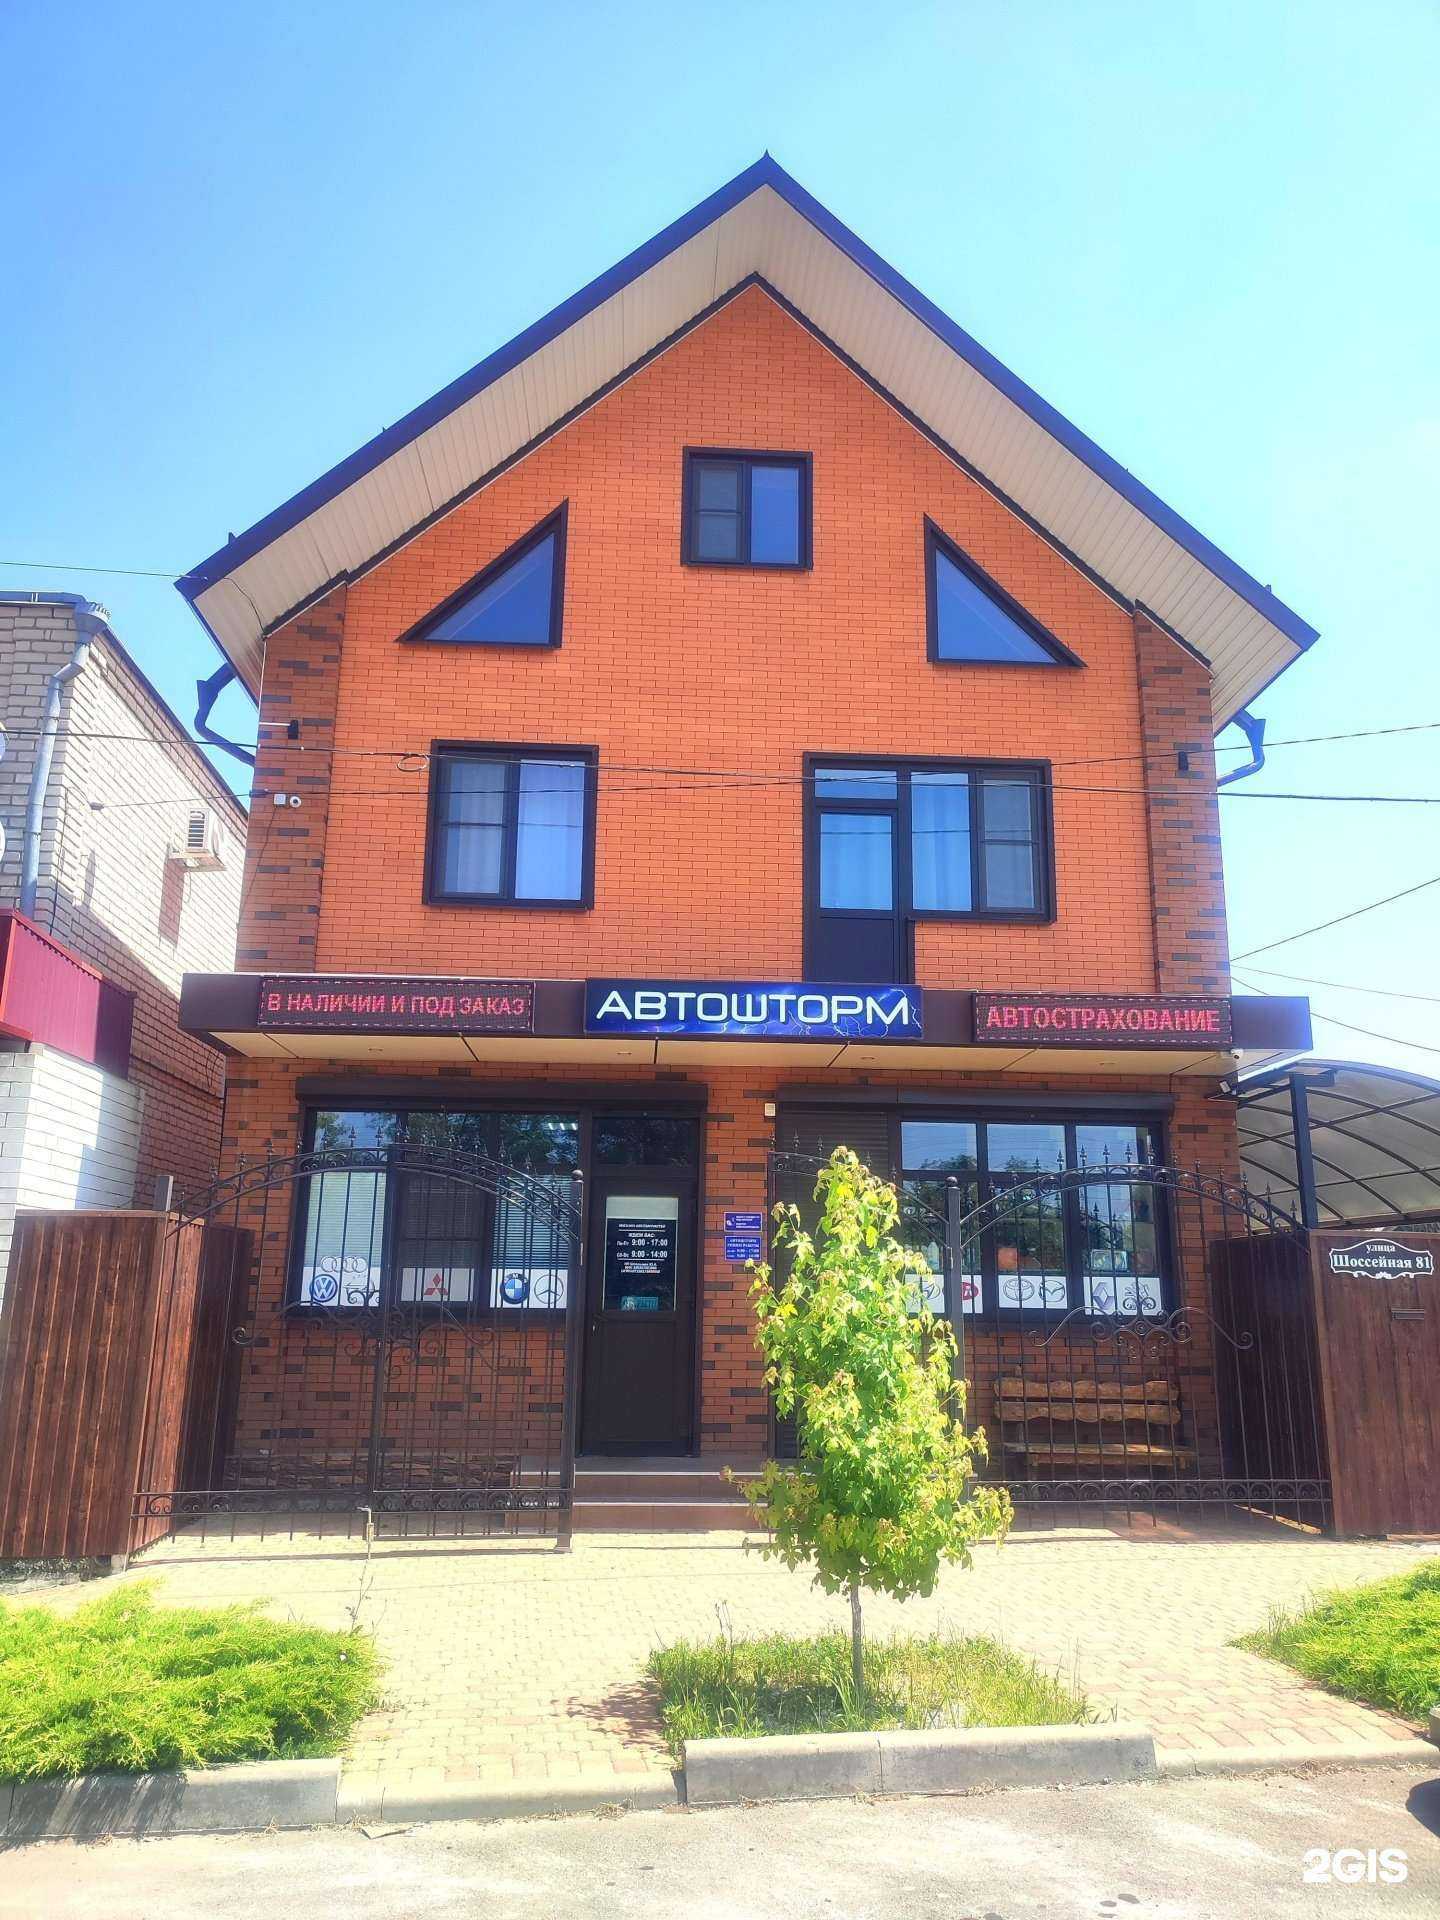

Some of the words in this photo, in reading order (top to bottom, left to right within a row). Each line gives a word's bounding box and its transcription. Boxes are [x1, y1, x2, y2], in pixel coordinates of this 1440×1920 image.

[267, 993, 281, 1011] В
[287, 993, 385, 1013] НАЛИЧИИ
[391, 995, 404, 1013] И
[411, 996, 454, 1018] ПОД
[459, 997, 524, 1015] ЗАКАЗ
[596, 990, 909, 1025] АВТОШТОРМ
[986, 1006, 1221, 1032] АВТОСТРАХОВАНИЕ
[631, 1238, 645, 1246] 9:00
[651, 1238, 668, 1247] 17:00
[1366, 1244, 1396, 1254] улица
[631, 1250, 645, 1258] 9:00
[650, 1250, 668, 1258] 14:00
[1332, 1254, 1412, 1268] Шоссейная
[1415, 1256, 1431, 1269] 81
